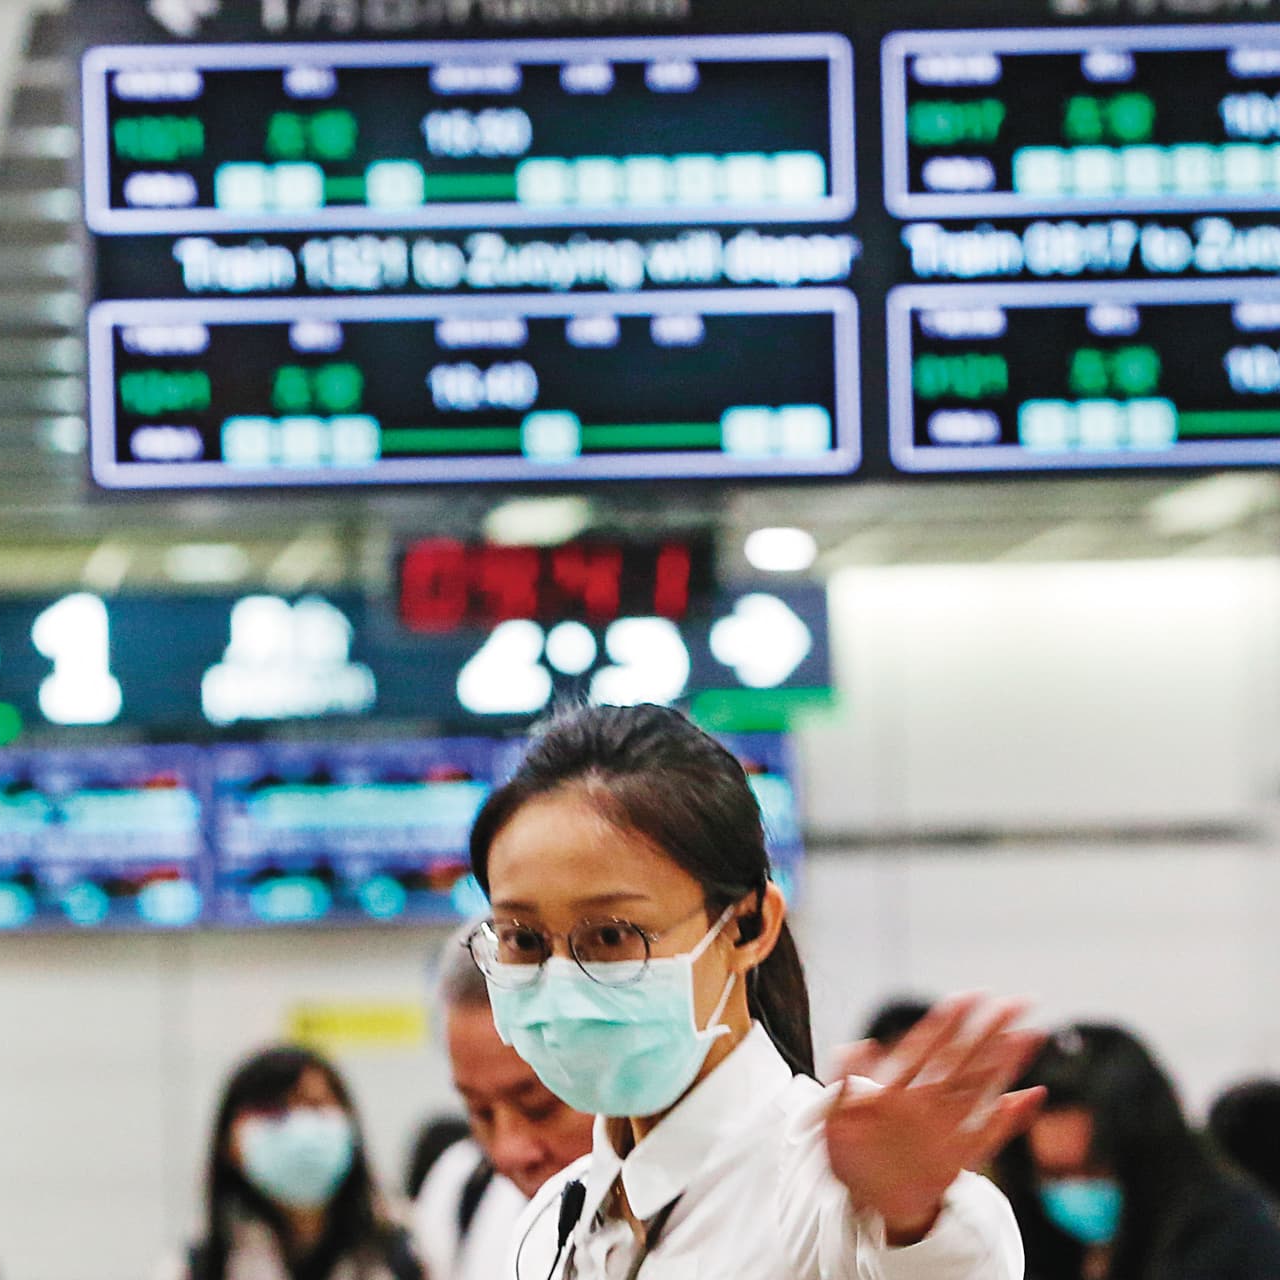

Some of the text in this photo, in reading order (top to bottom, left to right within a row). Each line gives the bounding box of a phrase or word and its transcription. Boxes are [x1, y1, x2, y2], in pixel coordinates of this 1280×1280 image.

[173, 236, 296, 291] Train
[412, 236, 465, 290] to
[464, 231, 645, 291] Zuoying
[646, 230, 721, 284] will
[902, 223, 1022, 278] Train
[1140, 221, 1193, 273] to
